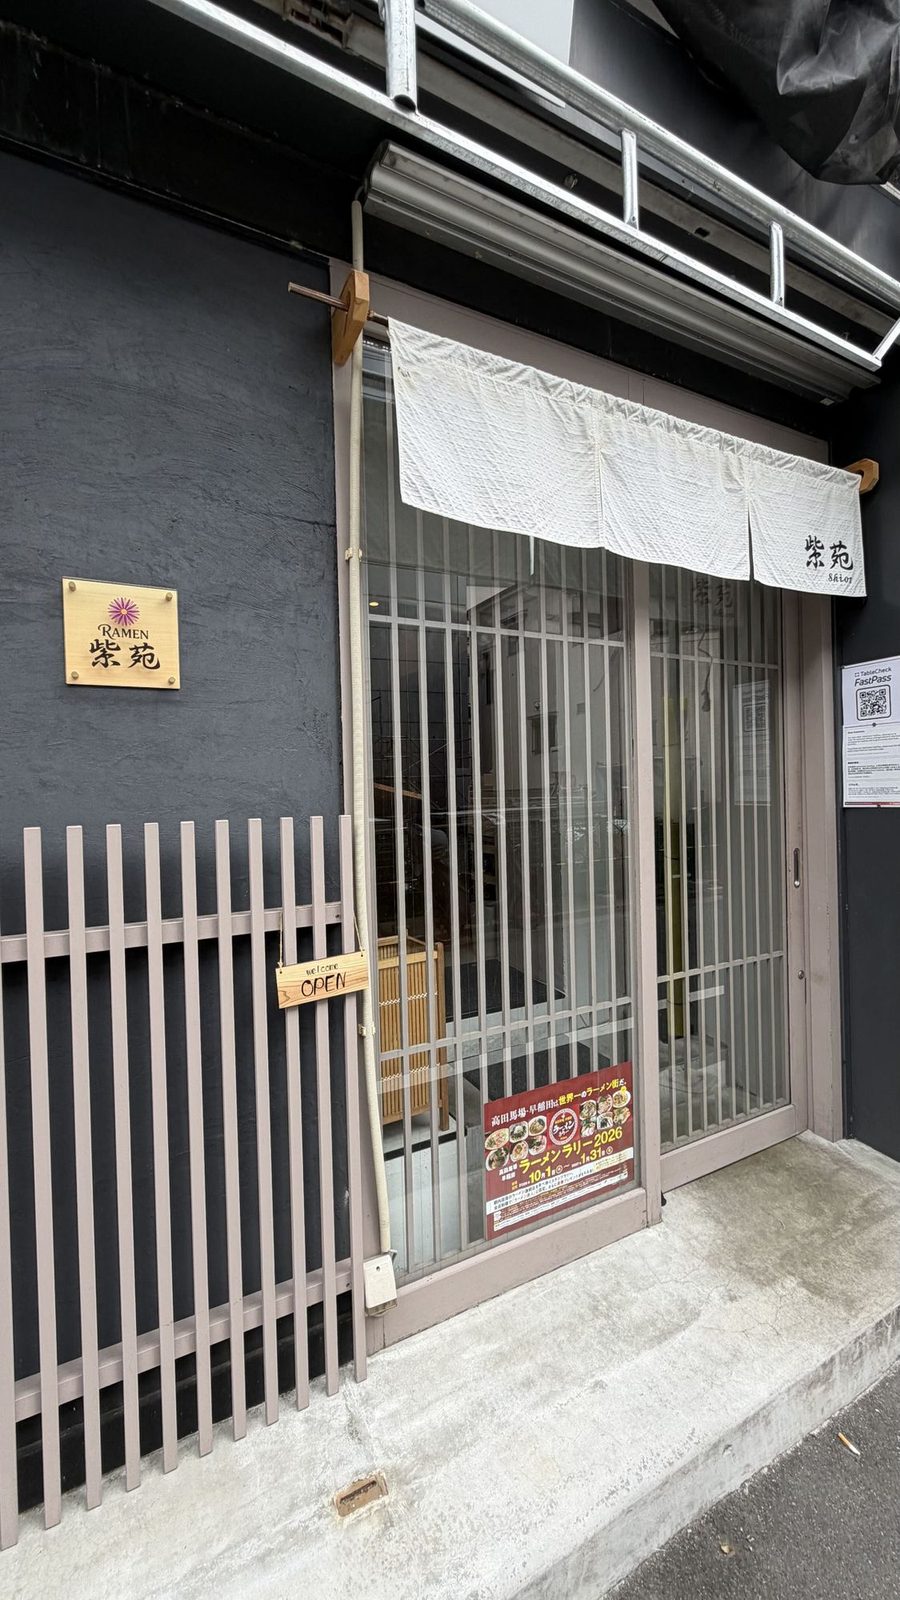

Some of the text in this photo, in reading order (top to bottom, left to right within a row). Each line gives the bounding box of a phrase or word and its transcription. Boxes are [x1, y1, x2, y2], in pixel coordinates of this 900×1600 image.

[805, 535, 853, 570] 紫苑
[98, 624, 149, 639] RAMEN
[89, 639, 160, 670] 紫苑
[861, 667, 891, 676] TableCheck
[854, 675, 892, 687] FastPass
[306, 963, 338, 976] welcome
[301, 972, 346, 997] OPEN
